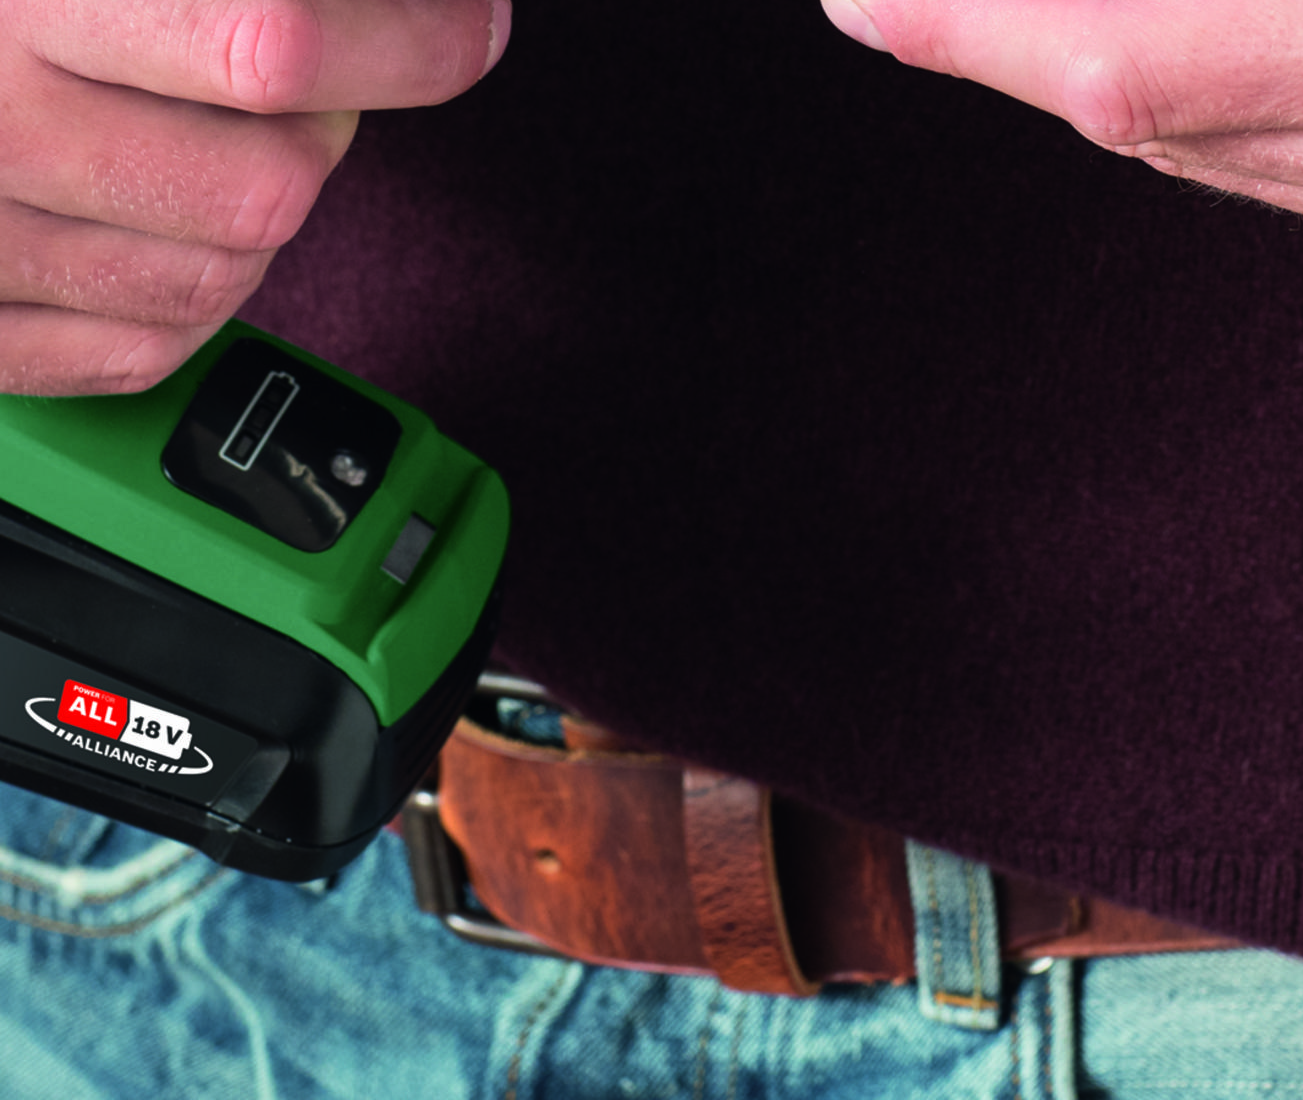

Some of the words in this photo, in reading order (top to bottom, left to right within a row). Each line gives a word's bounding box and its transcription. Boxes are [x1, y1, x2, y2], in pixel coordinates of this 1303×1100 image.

[73, 685, 101, 699] POWER
[102, 694, 116, 704] FOR
[69, 696, 117, 726] ALL
[132, 716, 162, 740] 18
[166, 725, 184, 746] V
[72, 735, 158, 773] ALLIANCE
